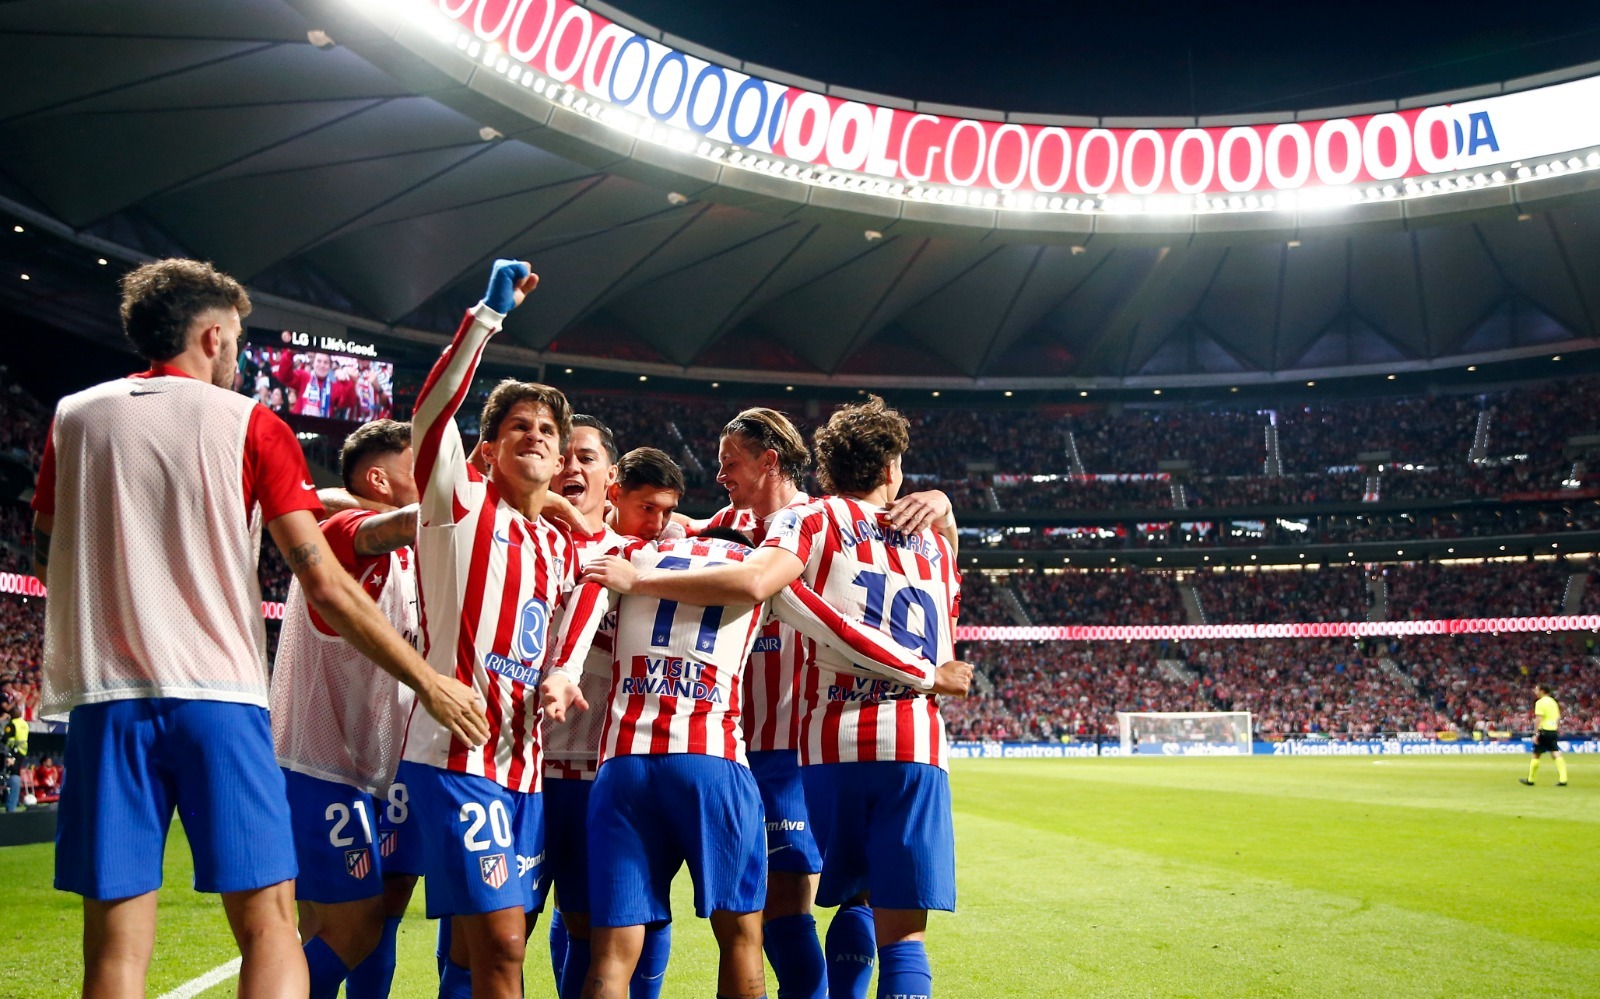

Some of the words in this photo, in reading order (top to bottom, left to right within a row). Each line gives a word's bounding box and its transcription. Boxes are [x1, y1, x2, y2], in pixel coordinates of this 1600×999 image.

[292, 332, 309, 347] LG
[757, 638, 779, 650] AIR
[487, 654, 532, 683] RIYADH
[646, 658, 707, 680] VISIT
[622, 677, 723, 704] RWANDA
[982, 744, 1002, 757] 39
[1004, 745, 1063, 757] centros
[1273, 742, 1290, 755] 21
[1291, 741, 1369, 756] Hospitales
[1382, 742, 1399, 755] 39
[1403, 742, 1461, 755] centros
[1462, 741, 1526, 754] médicos
[380, 783, 409, 824] 8
[325, 800, 372, 848] 21
[459, 800, 512, 852] 20
[767, 819, 804, 831] mAve
